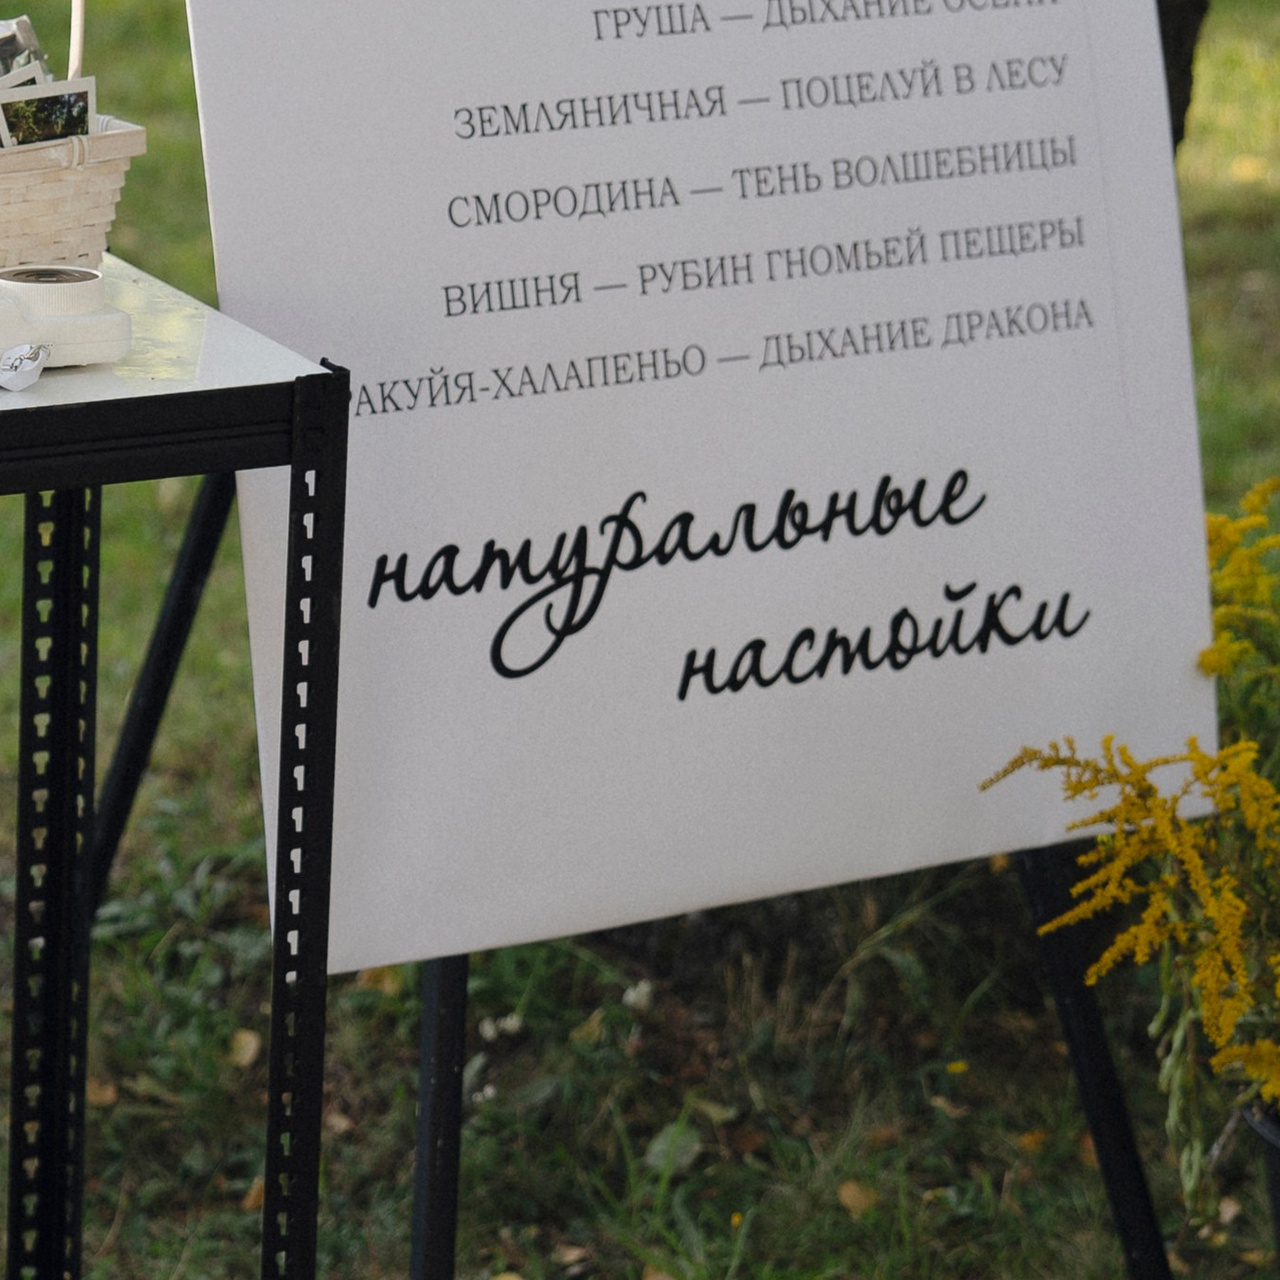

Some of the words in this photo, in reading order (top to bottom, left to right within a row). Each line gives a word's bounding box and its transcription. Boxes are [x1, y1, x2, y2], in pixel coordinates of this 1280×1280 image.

[593, 3, 711, 41] ГРУША
[454, 85, 727, 140] ЗЕМЛЯНИЧНАЯ
[781, 59, 943, 111] ПОЦЕЛУЙ
[953, 63, 976, 95] В
[986, 54, 1067, 93] ЛЕСУ
[447, 176, 680, 228] СМОРОДИНА
[731, 162, 822, 200] ТЕНЬ
[831, 135, 1077, 190] ВОЛШЕБНИЦЫ
[443, 272, 582, 317] ВИШНЯ
[638, 253, 753, 296] РУБИН
[766, 227, 928, 282] ГНОМЬЕЙ
[939, 216, 1085, 263] ПЕЩЕРЫ
[354, 345, 706, 417] АКУЙЯ-ХАЛАПЕНЬО
[759, 317, 932, 371] ДЫХАНИЕ
[941, 298, 1095, 348] ДРАКОНА
[367, 469, 988, 680] натуральные
[677, 581, 1091, 702] настойки
